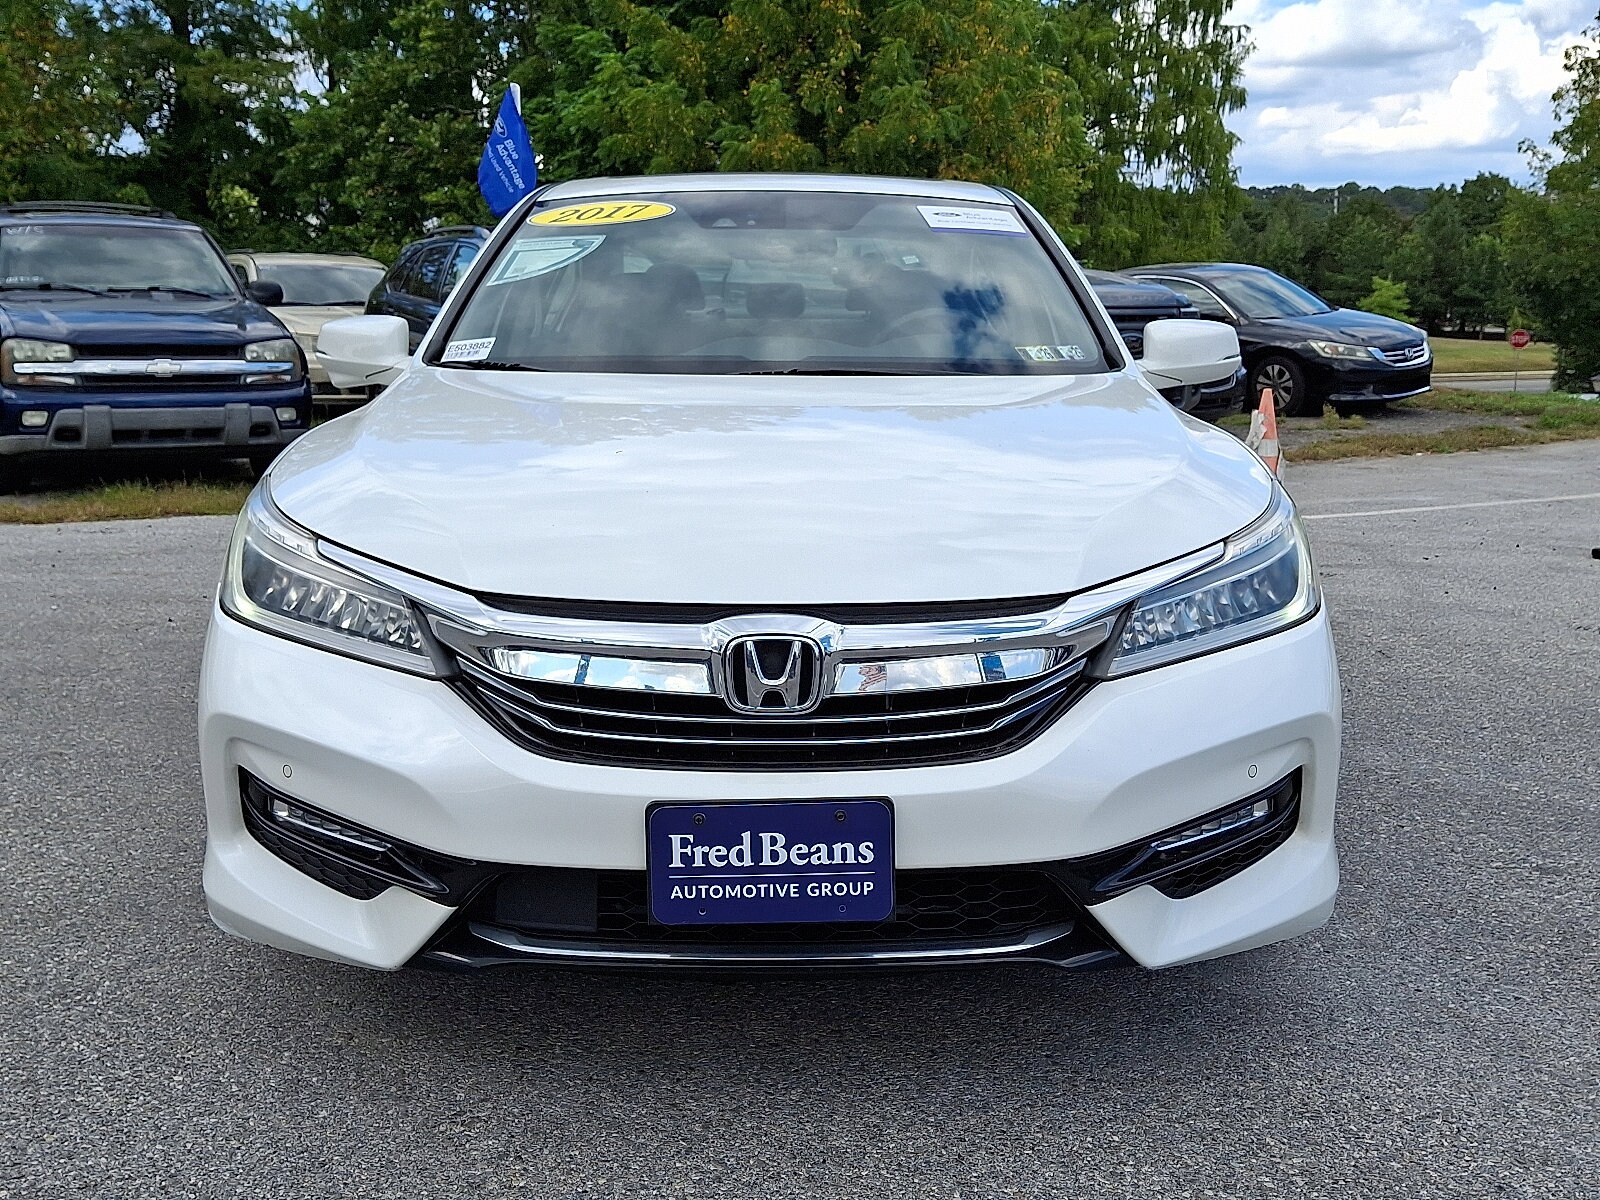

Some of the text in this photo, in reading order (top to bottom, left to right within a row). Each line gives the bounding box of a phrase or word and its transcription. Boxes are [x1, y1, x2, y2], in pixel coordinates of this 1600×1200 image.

[504, 139, 519, 160] Blue
[496, 144, 526, 190] Advantage
[549, 204, 652, 224] 2017
[668, 830, 875, 868] Fred Beans
[670, 881, 874, 900] AUTOMOTIVE GROUP
